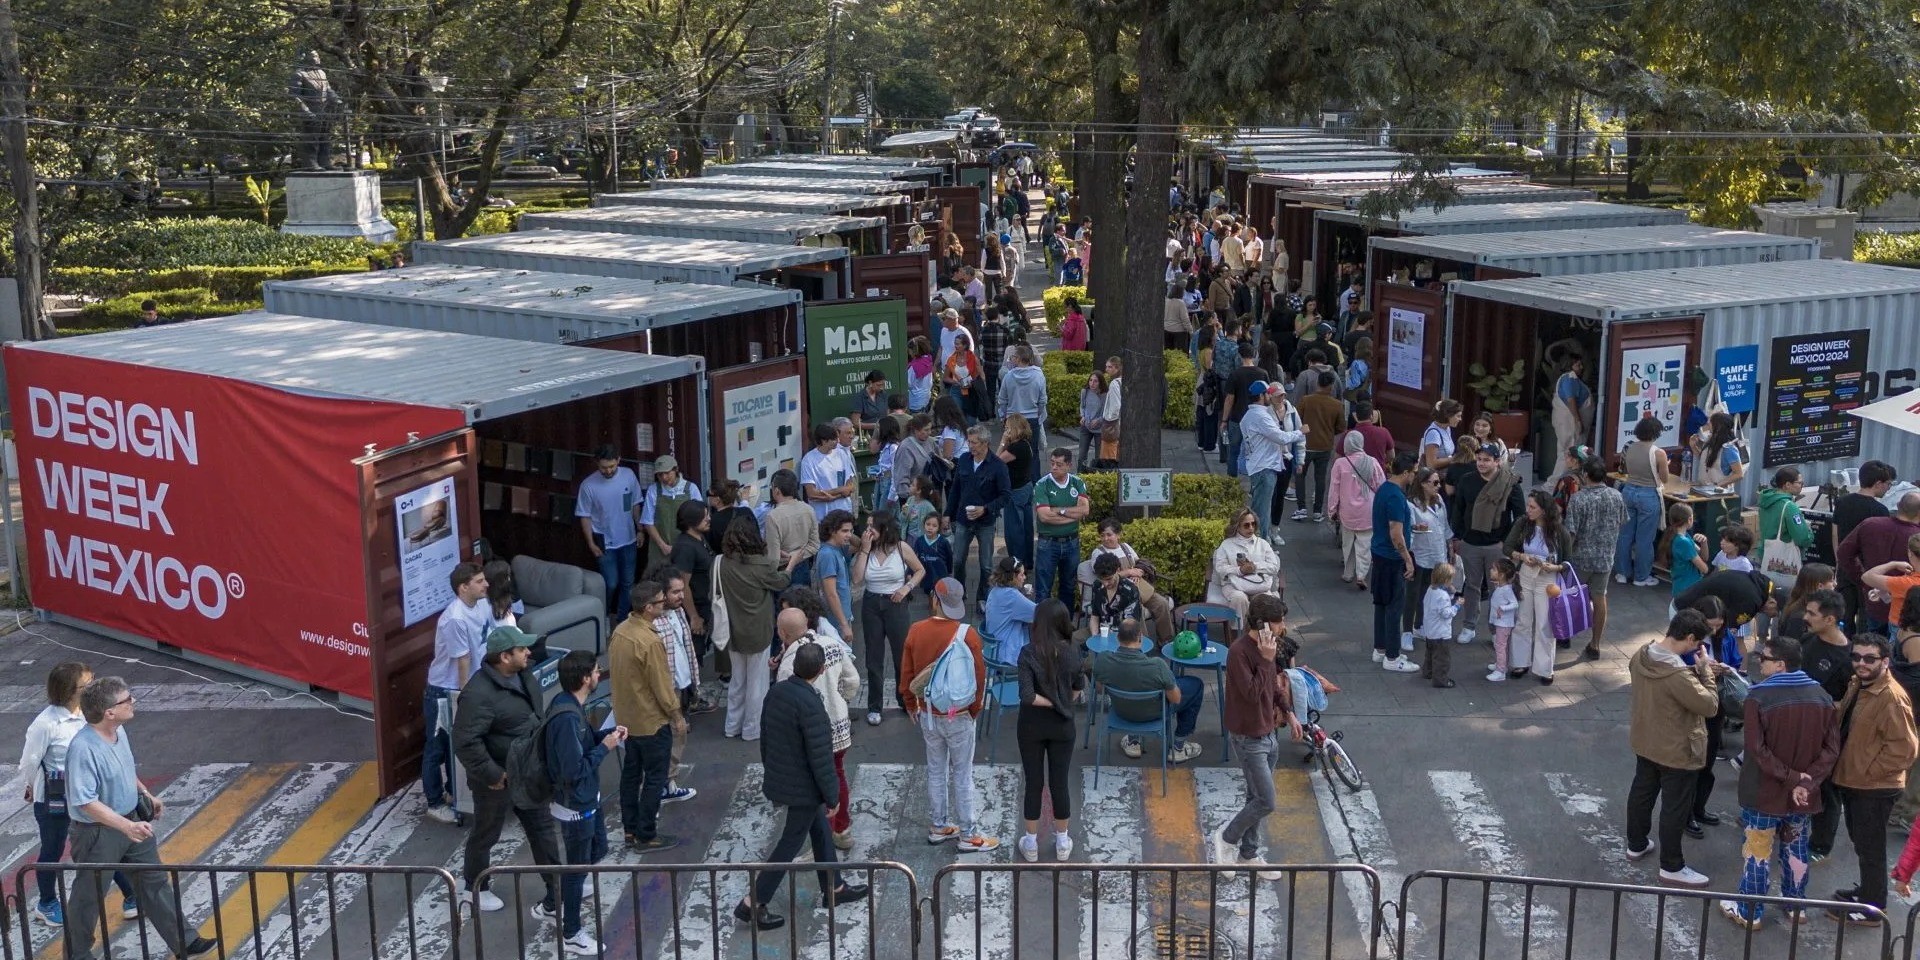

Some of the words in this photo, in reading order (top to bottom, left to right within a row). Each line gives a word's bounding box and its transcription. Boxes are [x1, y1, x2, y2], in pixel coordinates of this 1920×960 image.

[1791, 342, 1824, 354] DESIGN
[1824, 340, 1851, 351] WEEK
[1790, 353, 1825, 365] MEXICO
[1826, 351, 1849, 361] 2024
[1720, 364, 1754, 375] SAMPLE
[1726, 373, 1748, 383] SALE
[828, 386, 836, 397] DE
[731, 394, 773, 415] TOCAYO
[28, 386, 198, 466] DESIGN
[35, 457, 175, 536] WEEK
[404, 552, 423, 565] CACAO
[300, 629, 371, 658] www.designw
[541, 671, 559, 687] CACA
